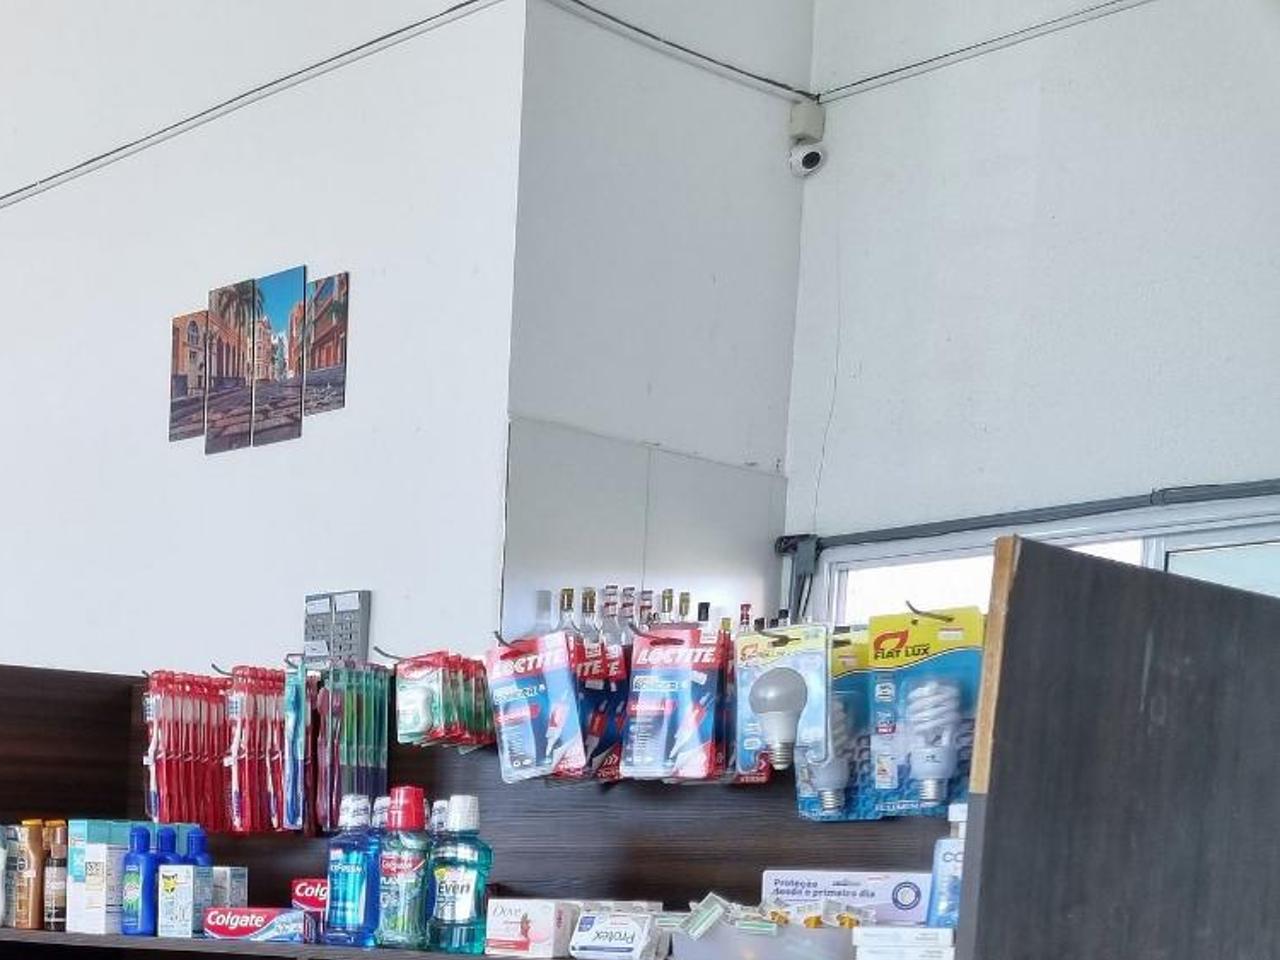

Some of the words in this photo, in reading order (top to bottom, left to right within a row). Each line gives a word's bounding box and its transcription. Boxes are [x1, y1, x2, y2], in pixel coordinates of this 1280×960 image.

[874, 648, 901, 661] FIAT
[904, 642, 929, 657] LUX
[294, 882, 328, 902] Colg
[206, 911, 265, 929] Colgate
[594, 930, 636, 944] Protex
